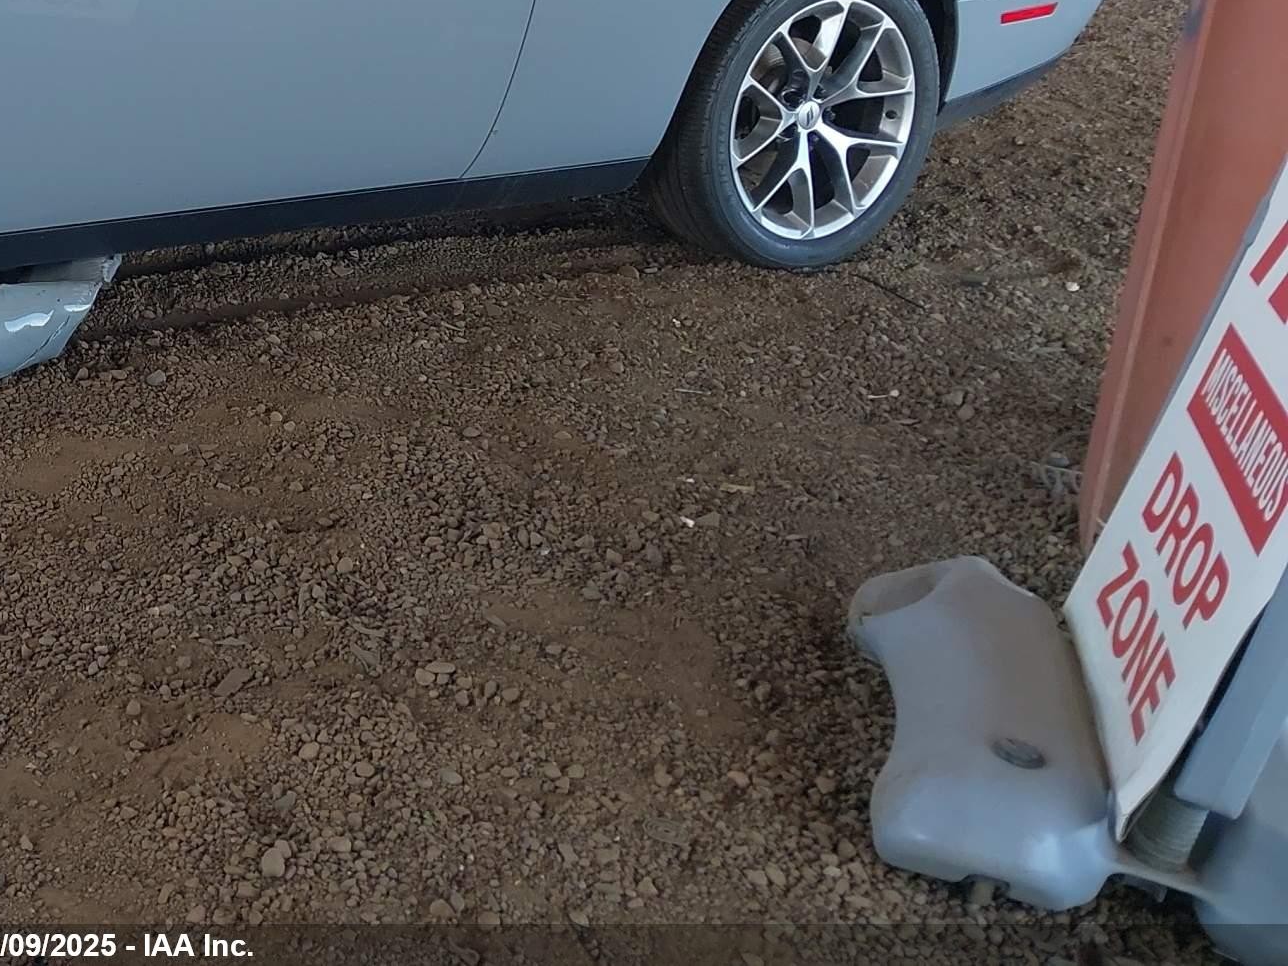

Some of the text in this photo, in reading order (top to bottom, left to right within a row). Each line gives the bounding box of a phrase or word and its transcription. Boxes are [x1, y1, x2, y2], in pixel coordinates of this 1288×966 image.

[1201, 348, 1288, 523] MISCELLANEOUS
[1142, 450, 1230, 631] DROP
[1096, 540, 1176, 747] ZONE
